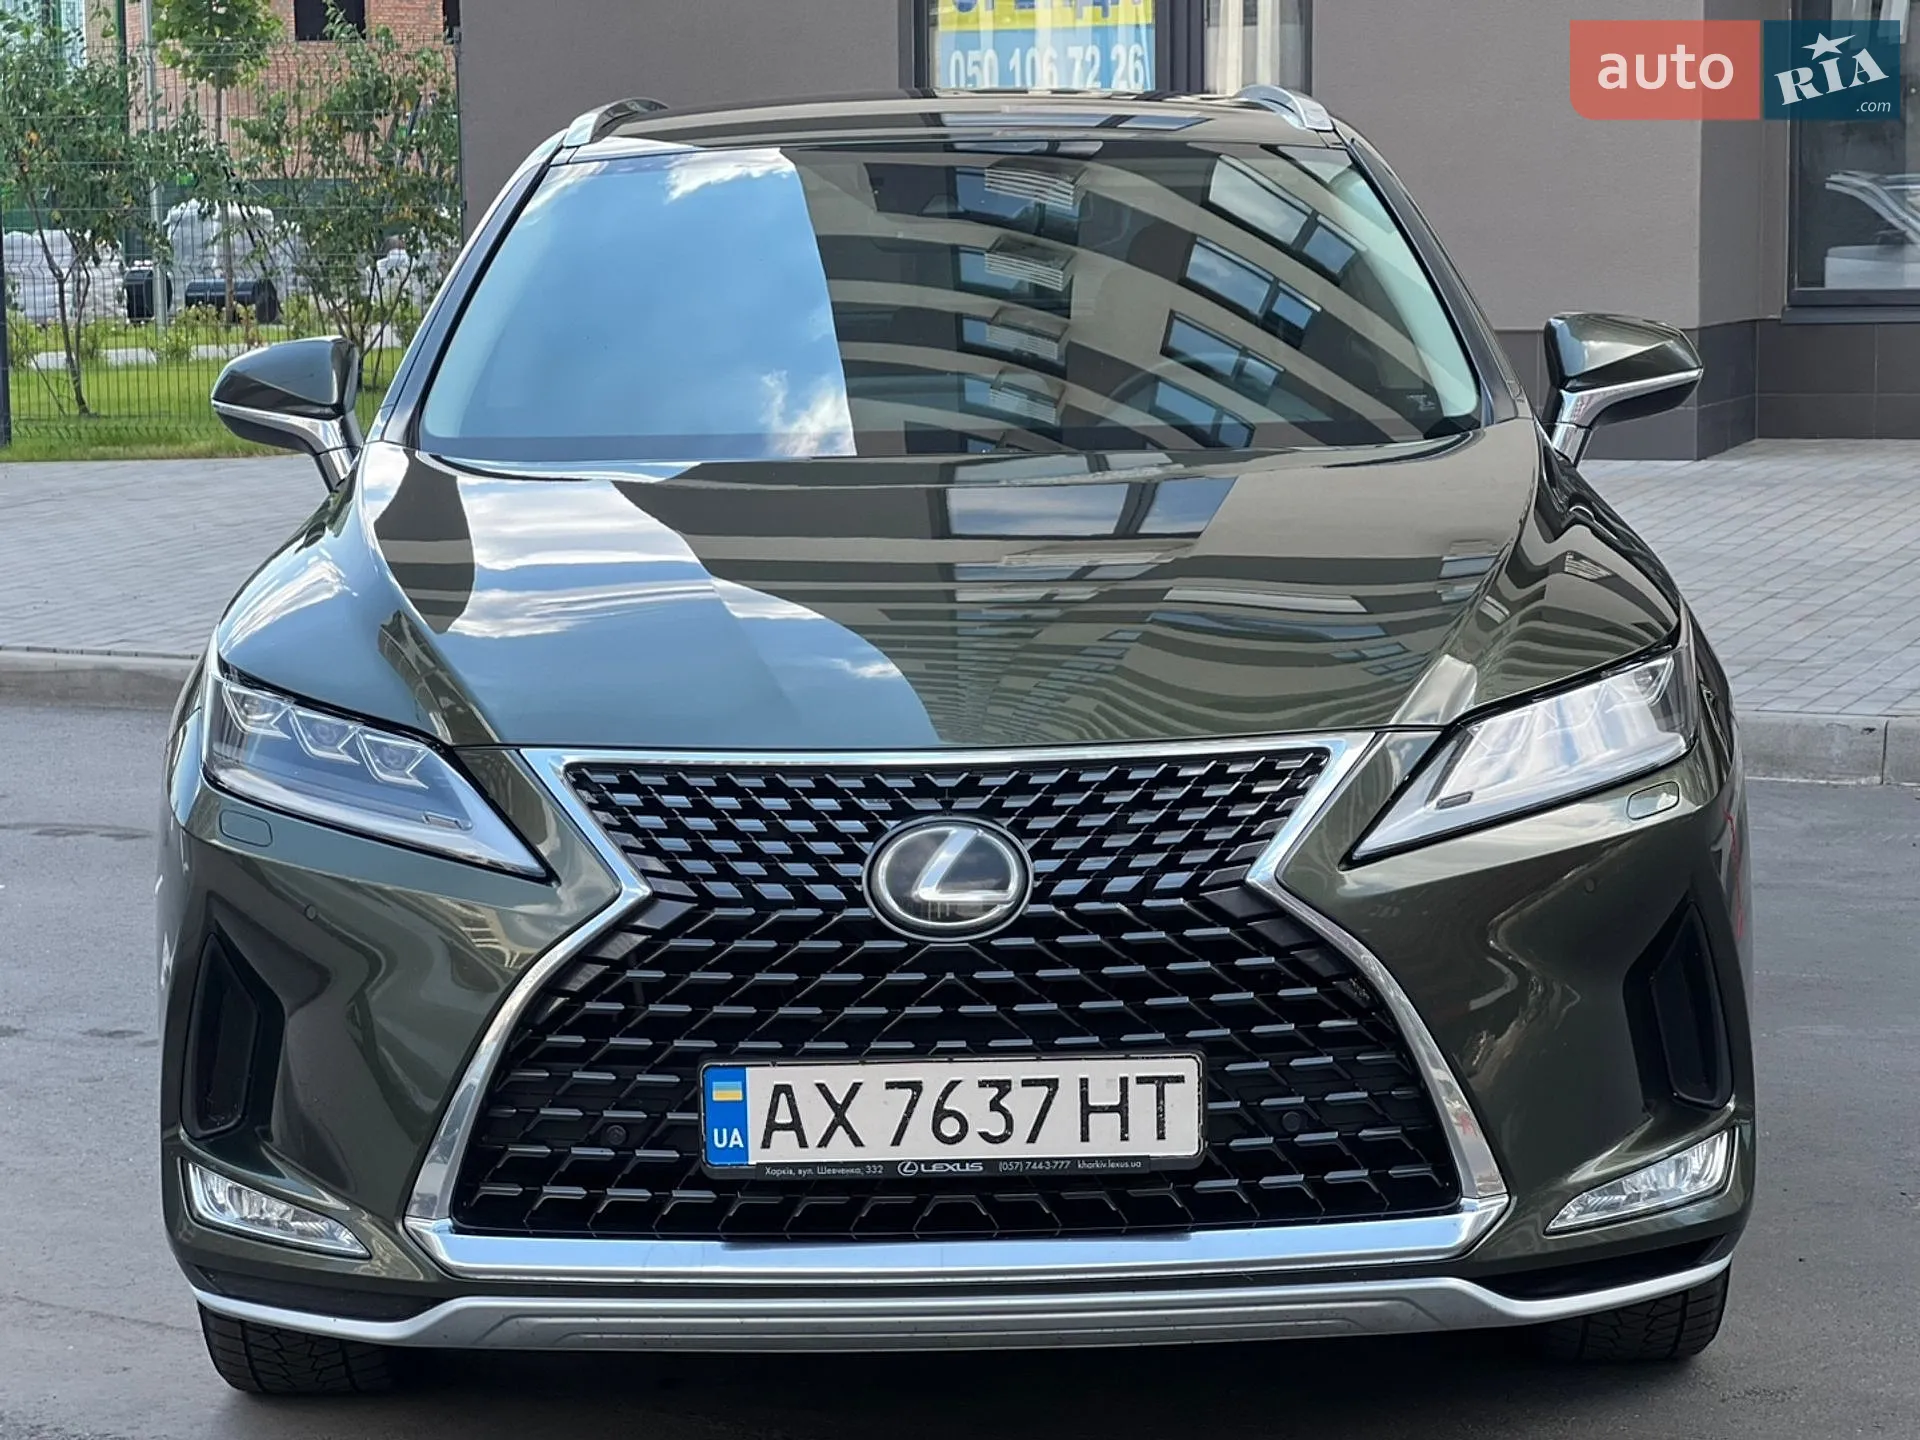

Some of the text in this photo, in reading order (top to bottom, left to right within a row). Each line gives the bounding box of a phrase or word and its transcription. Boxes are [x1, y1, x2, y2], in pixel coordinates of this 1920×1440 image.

[950, 43, 1144, 90] 050 106 72 26
[760, 1074, 1187, 1150] AX 7637 HT
[713, 1127, 744, 1149] UA
[865, 1164, 884, 1175] 332
[920, 1162, 983, 1172] LEXUS
